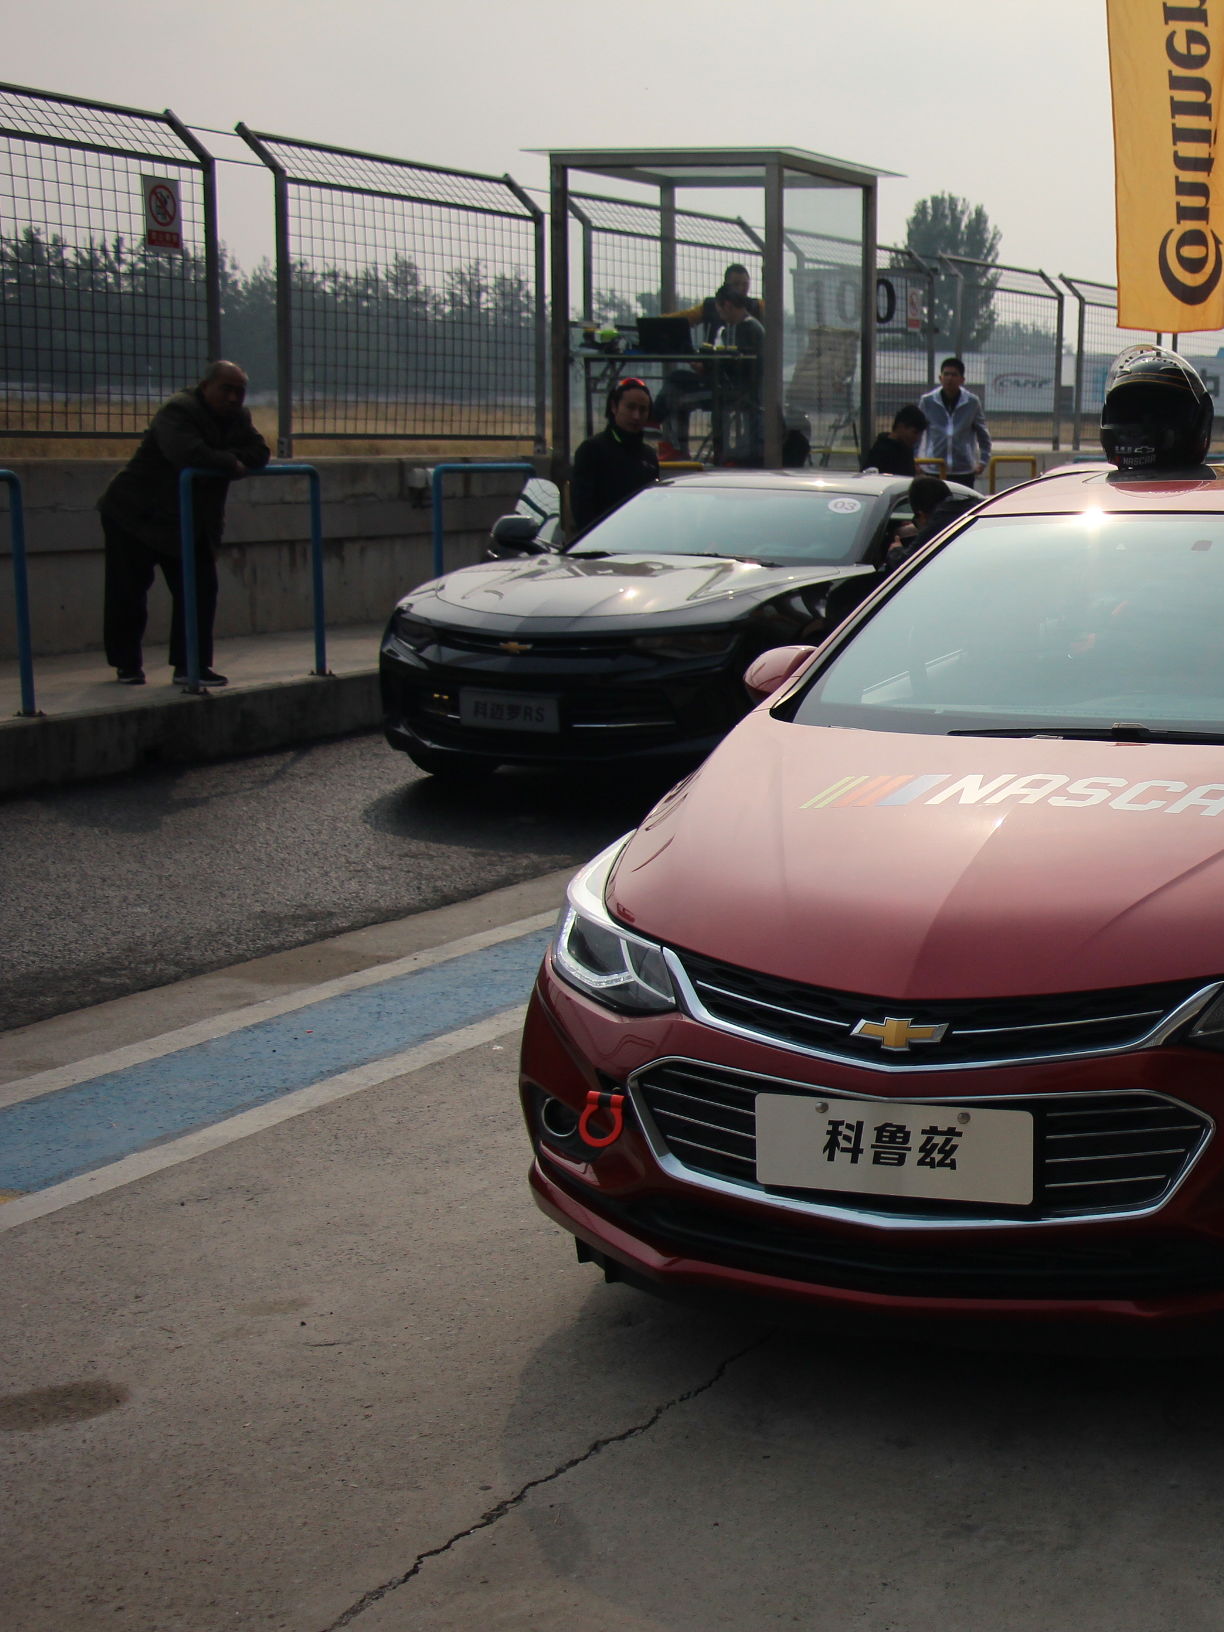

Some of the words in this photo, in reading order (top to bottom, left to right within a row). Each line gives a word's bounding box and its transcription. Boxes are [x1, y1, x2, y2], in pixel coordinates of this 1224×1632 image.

[834, 501, 857, 511] 03
[823, 1119, 963, 1170] 科鲁兹
